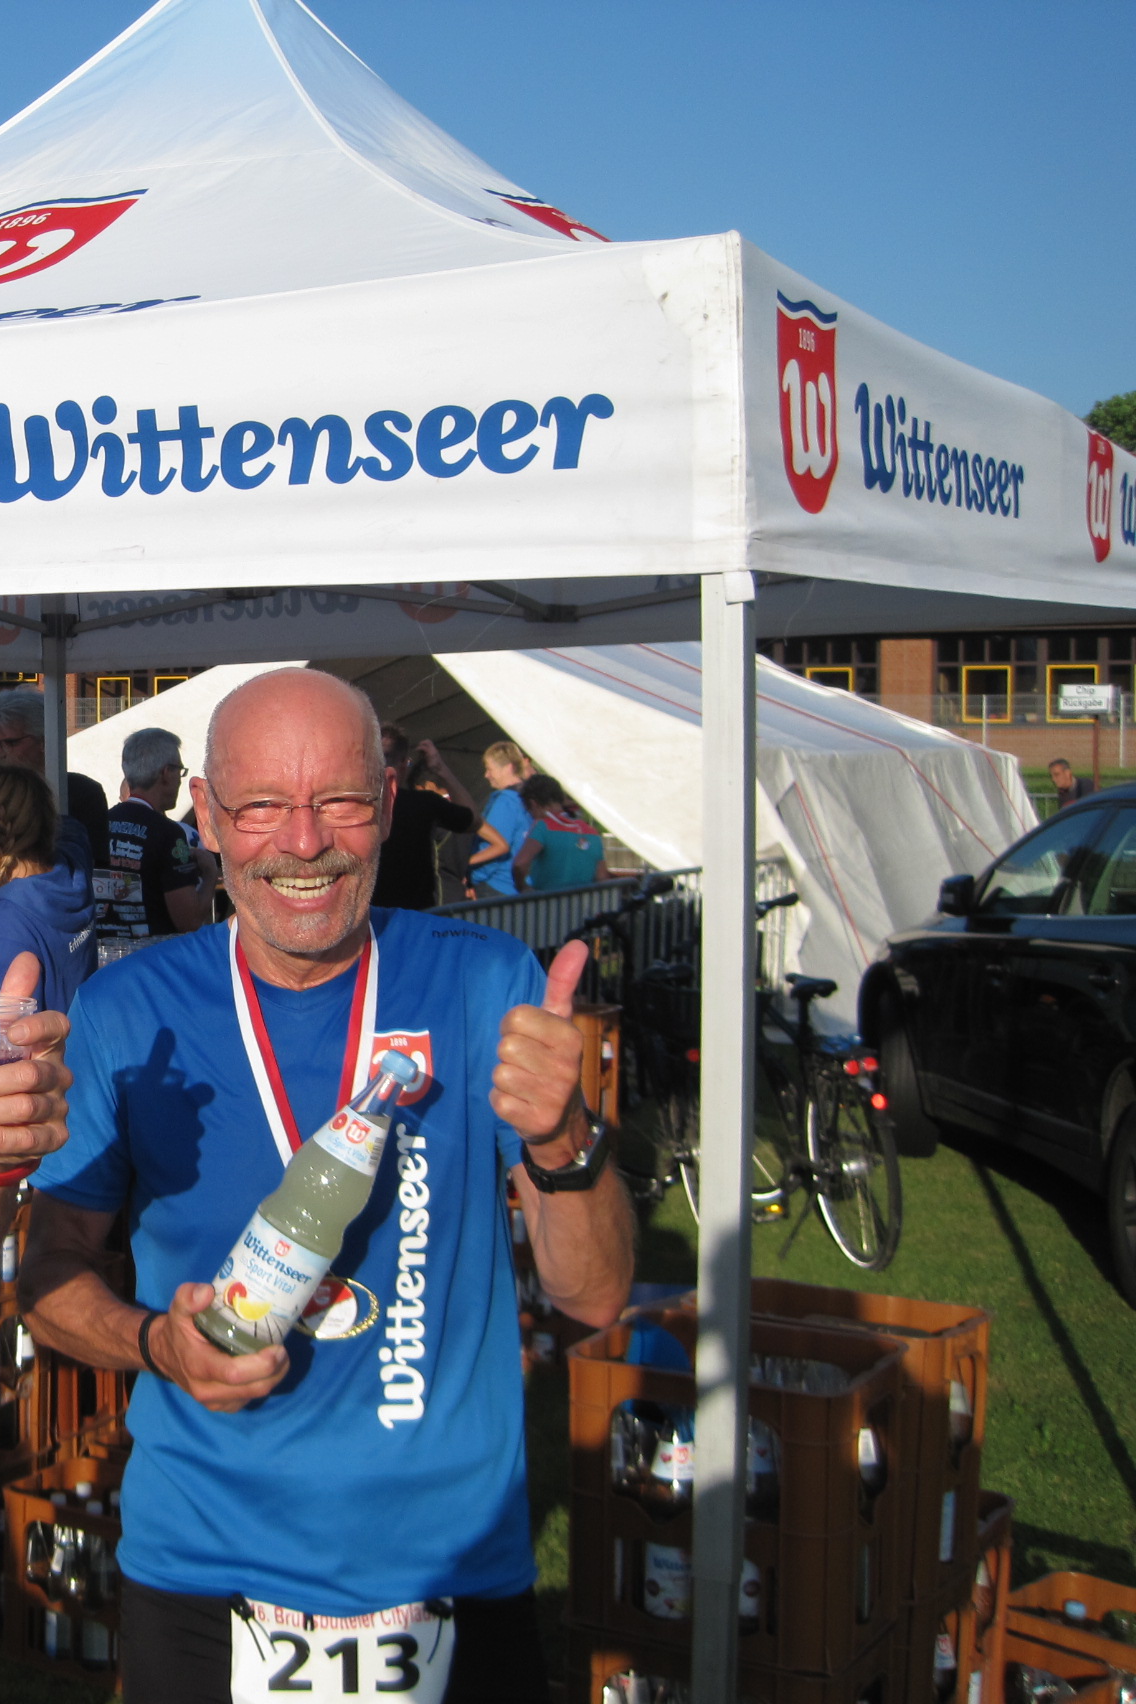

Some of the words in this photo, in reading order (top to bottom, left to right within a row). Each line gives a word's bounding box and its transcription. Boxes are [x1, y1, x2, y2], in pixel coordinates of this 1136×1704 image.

[799, 328, 816, 353] 1896
[854, 382, 1024, 519] Wittenseer
[1075, 686, 1096, 695] Chip
[389, 1037, 409, 1047] 1896
[243, 1230, 312, 1285] Wittenseer
[247, 1258, 272, 1284] Sport
[273, 1275, 297, 1295] Vital
[376, 1122, 430, 1429] Wittenseer
[268, 1631, 420, 1694] 213
